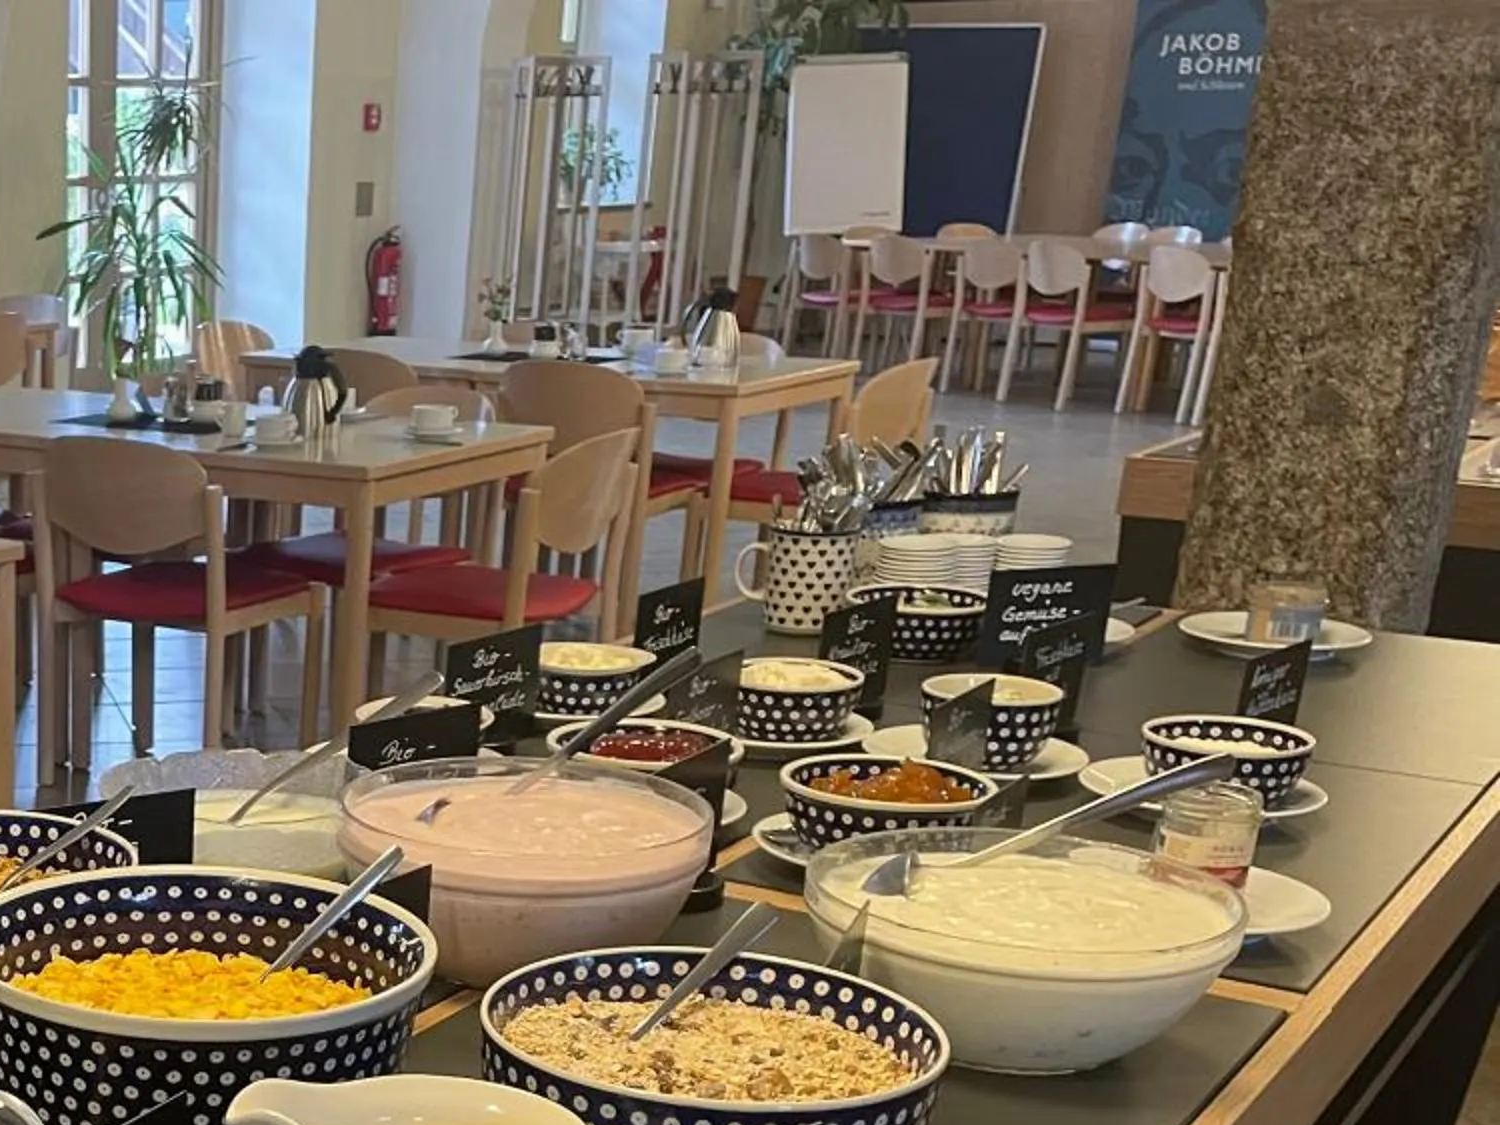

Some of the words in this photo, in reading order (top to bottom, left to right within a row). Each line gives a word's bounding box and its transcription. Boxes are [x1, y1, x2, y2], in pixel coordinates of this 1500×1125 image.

[1159, 33, 1241, 58] JAKOB
[471, 645, 512, 669] Bio-
[379, 737, 437, 766] Bio-
